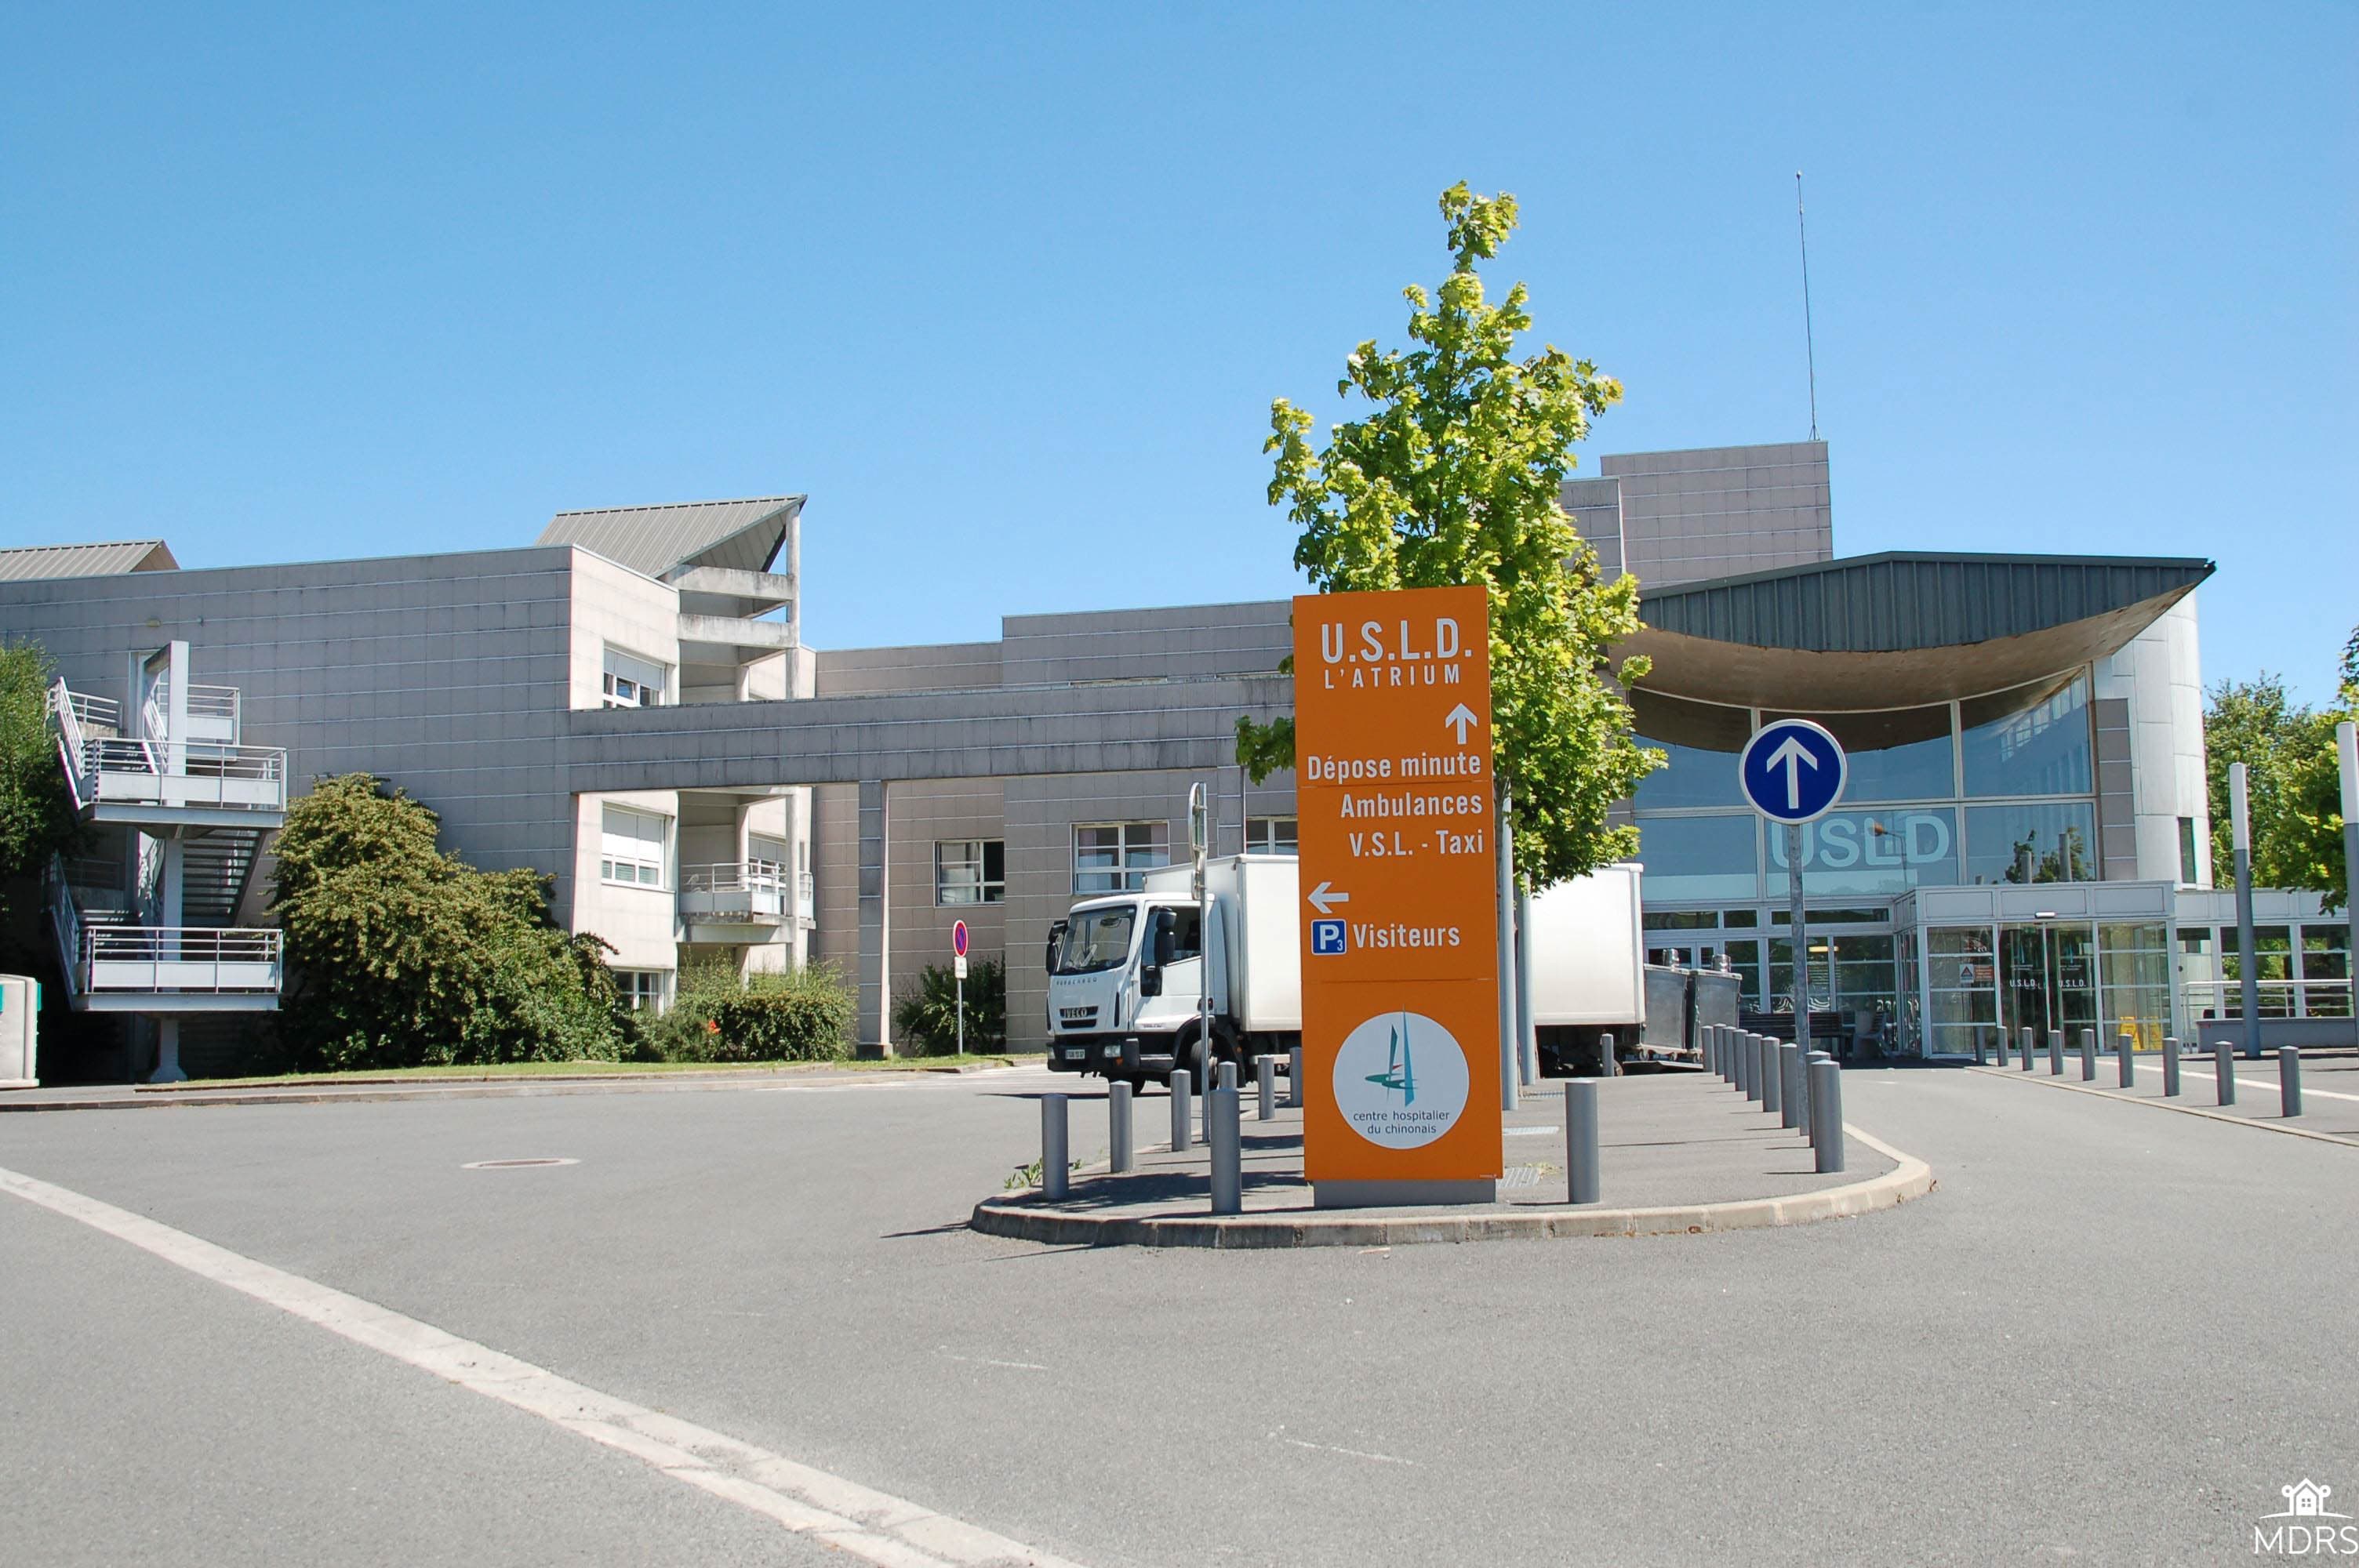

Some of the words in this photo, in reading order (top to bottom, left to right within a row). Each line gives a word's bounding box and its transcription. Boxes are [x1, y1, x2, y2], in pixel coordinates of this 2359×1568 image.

[1321, 618, 1472, 664] U.S.L.D.
[1325, 663, 1460, 690] L'ATRIUM
[1308, 755, 1391, 785] Dépose
[1401, 752, 1481, 776] minute
[1341, 792, 1483, 818] Ambulances
[1349, 831, 1413, 857] V.S.L.
[1435, 829, 1483, 855] Taxi
[1772, 815, 1950, 868] USLD
[1353, 924, 1460, 948] Visiteurs
[1063, 1007, 1088, 1018] IVECO
[1353, 1111, 1387, 1121] centre
[1393, 1109, 1450, 1122] hospitalier
[1367, 1124, 1381, 1134] du
[1385, 1123, 1437, 1134] chinonais
